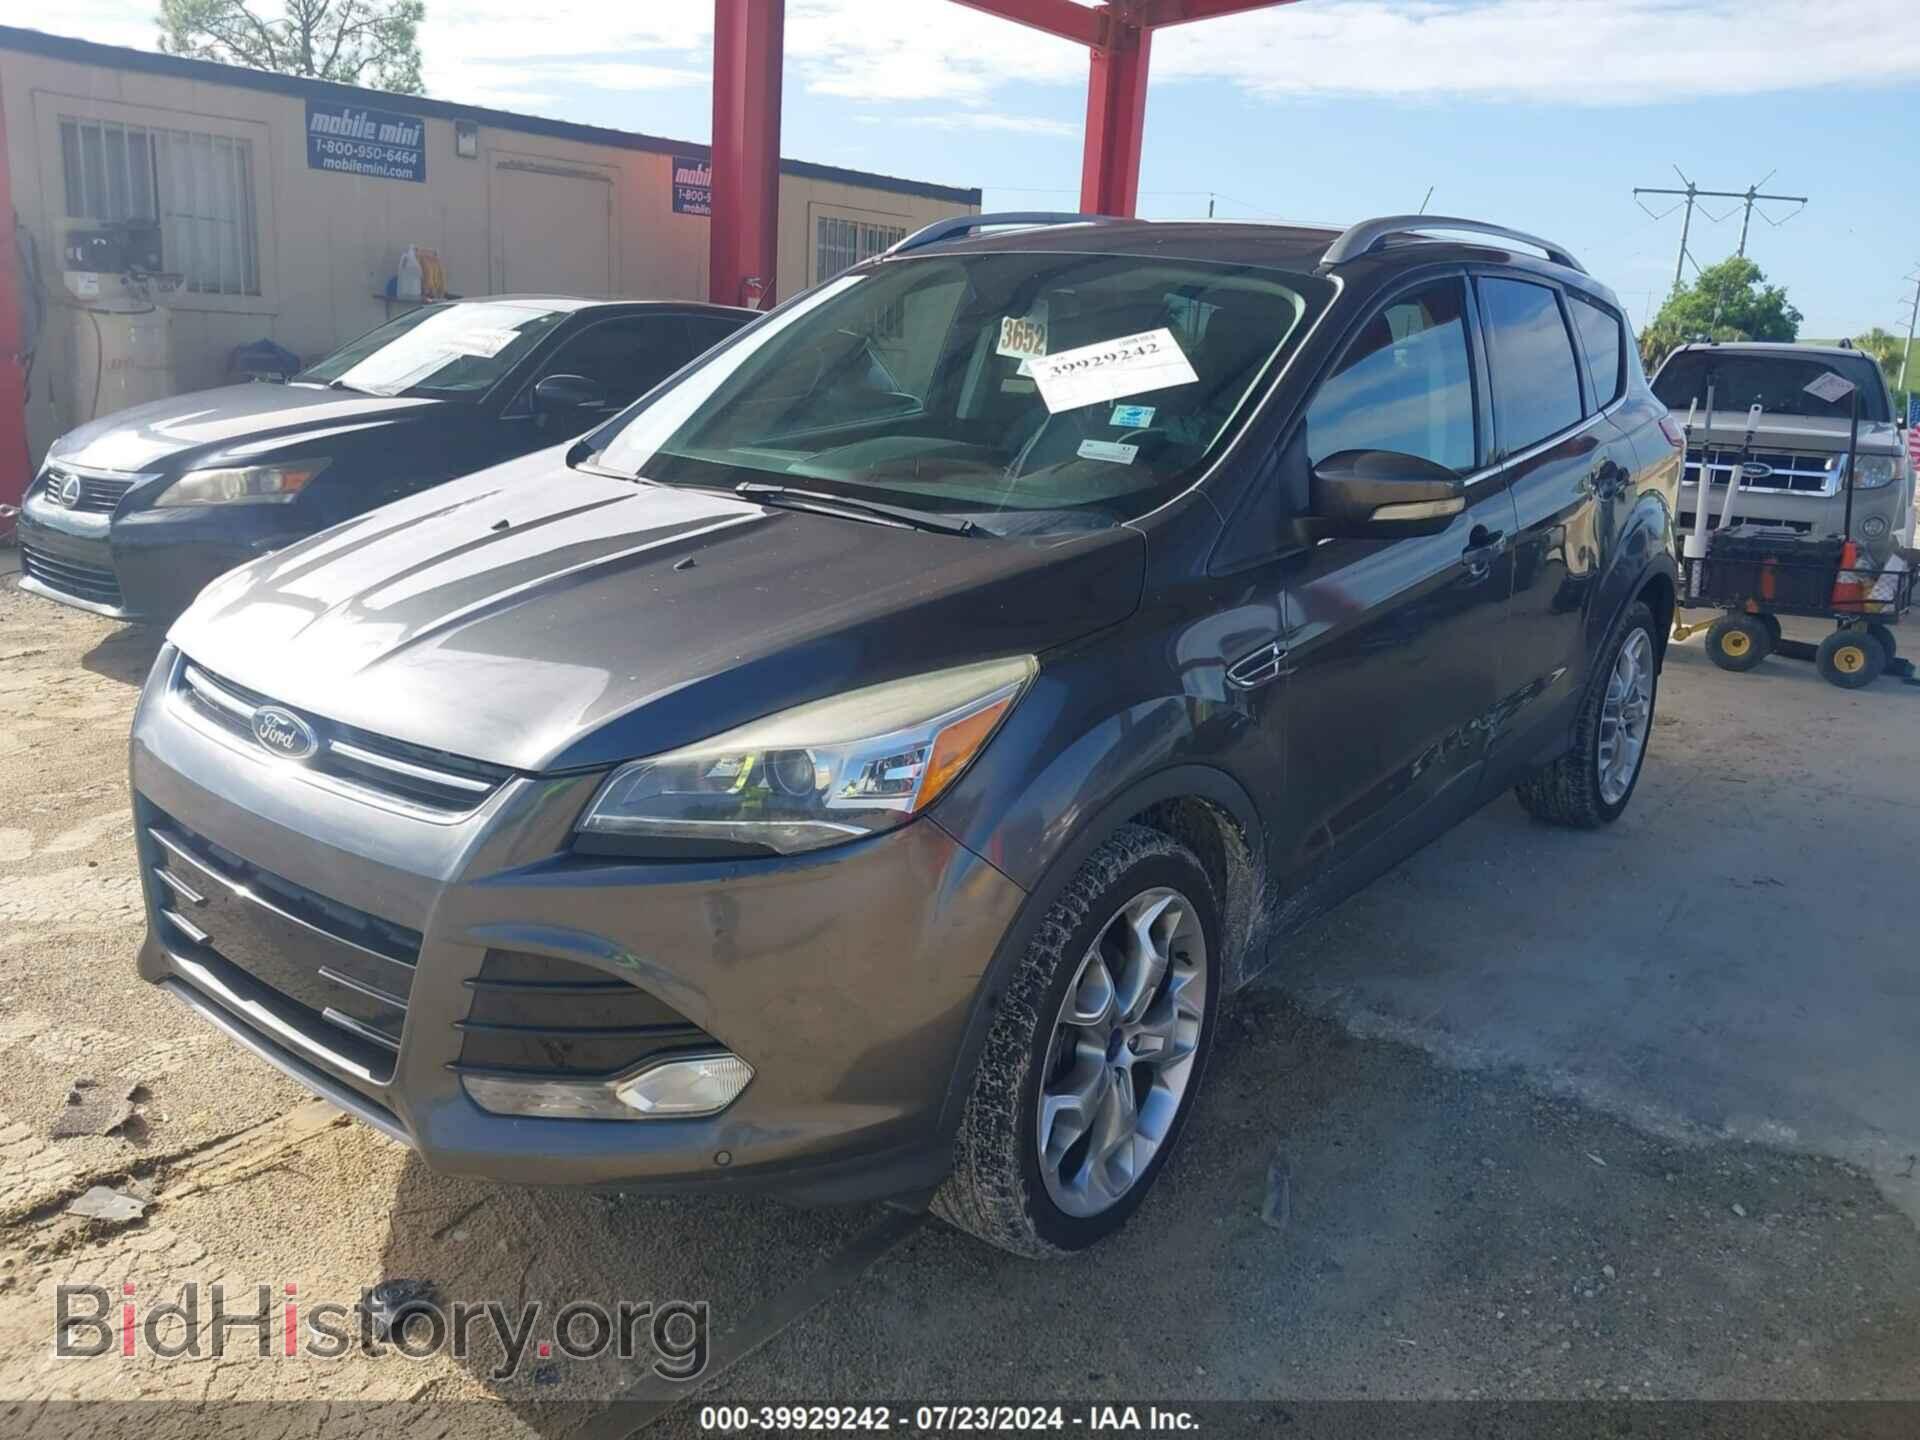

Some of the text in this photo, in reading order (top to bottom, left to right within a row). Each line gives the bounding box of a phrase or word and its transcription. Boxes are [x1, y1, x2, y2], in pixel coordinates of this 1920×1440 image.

[310, 109, 422, 146] mobile mini
[316, 139, 416, 165] 1-800-950-6464
[323, 157, 413, 178] mobilemini.com
[1002, 319, 1045, 355] 3652
[1049, 343, 1160, 378] 39929242
[260, 713, 296, 749] Ford
